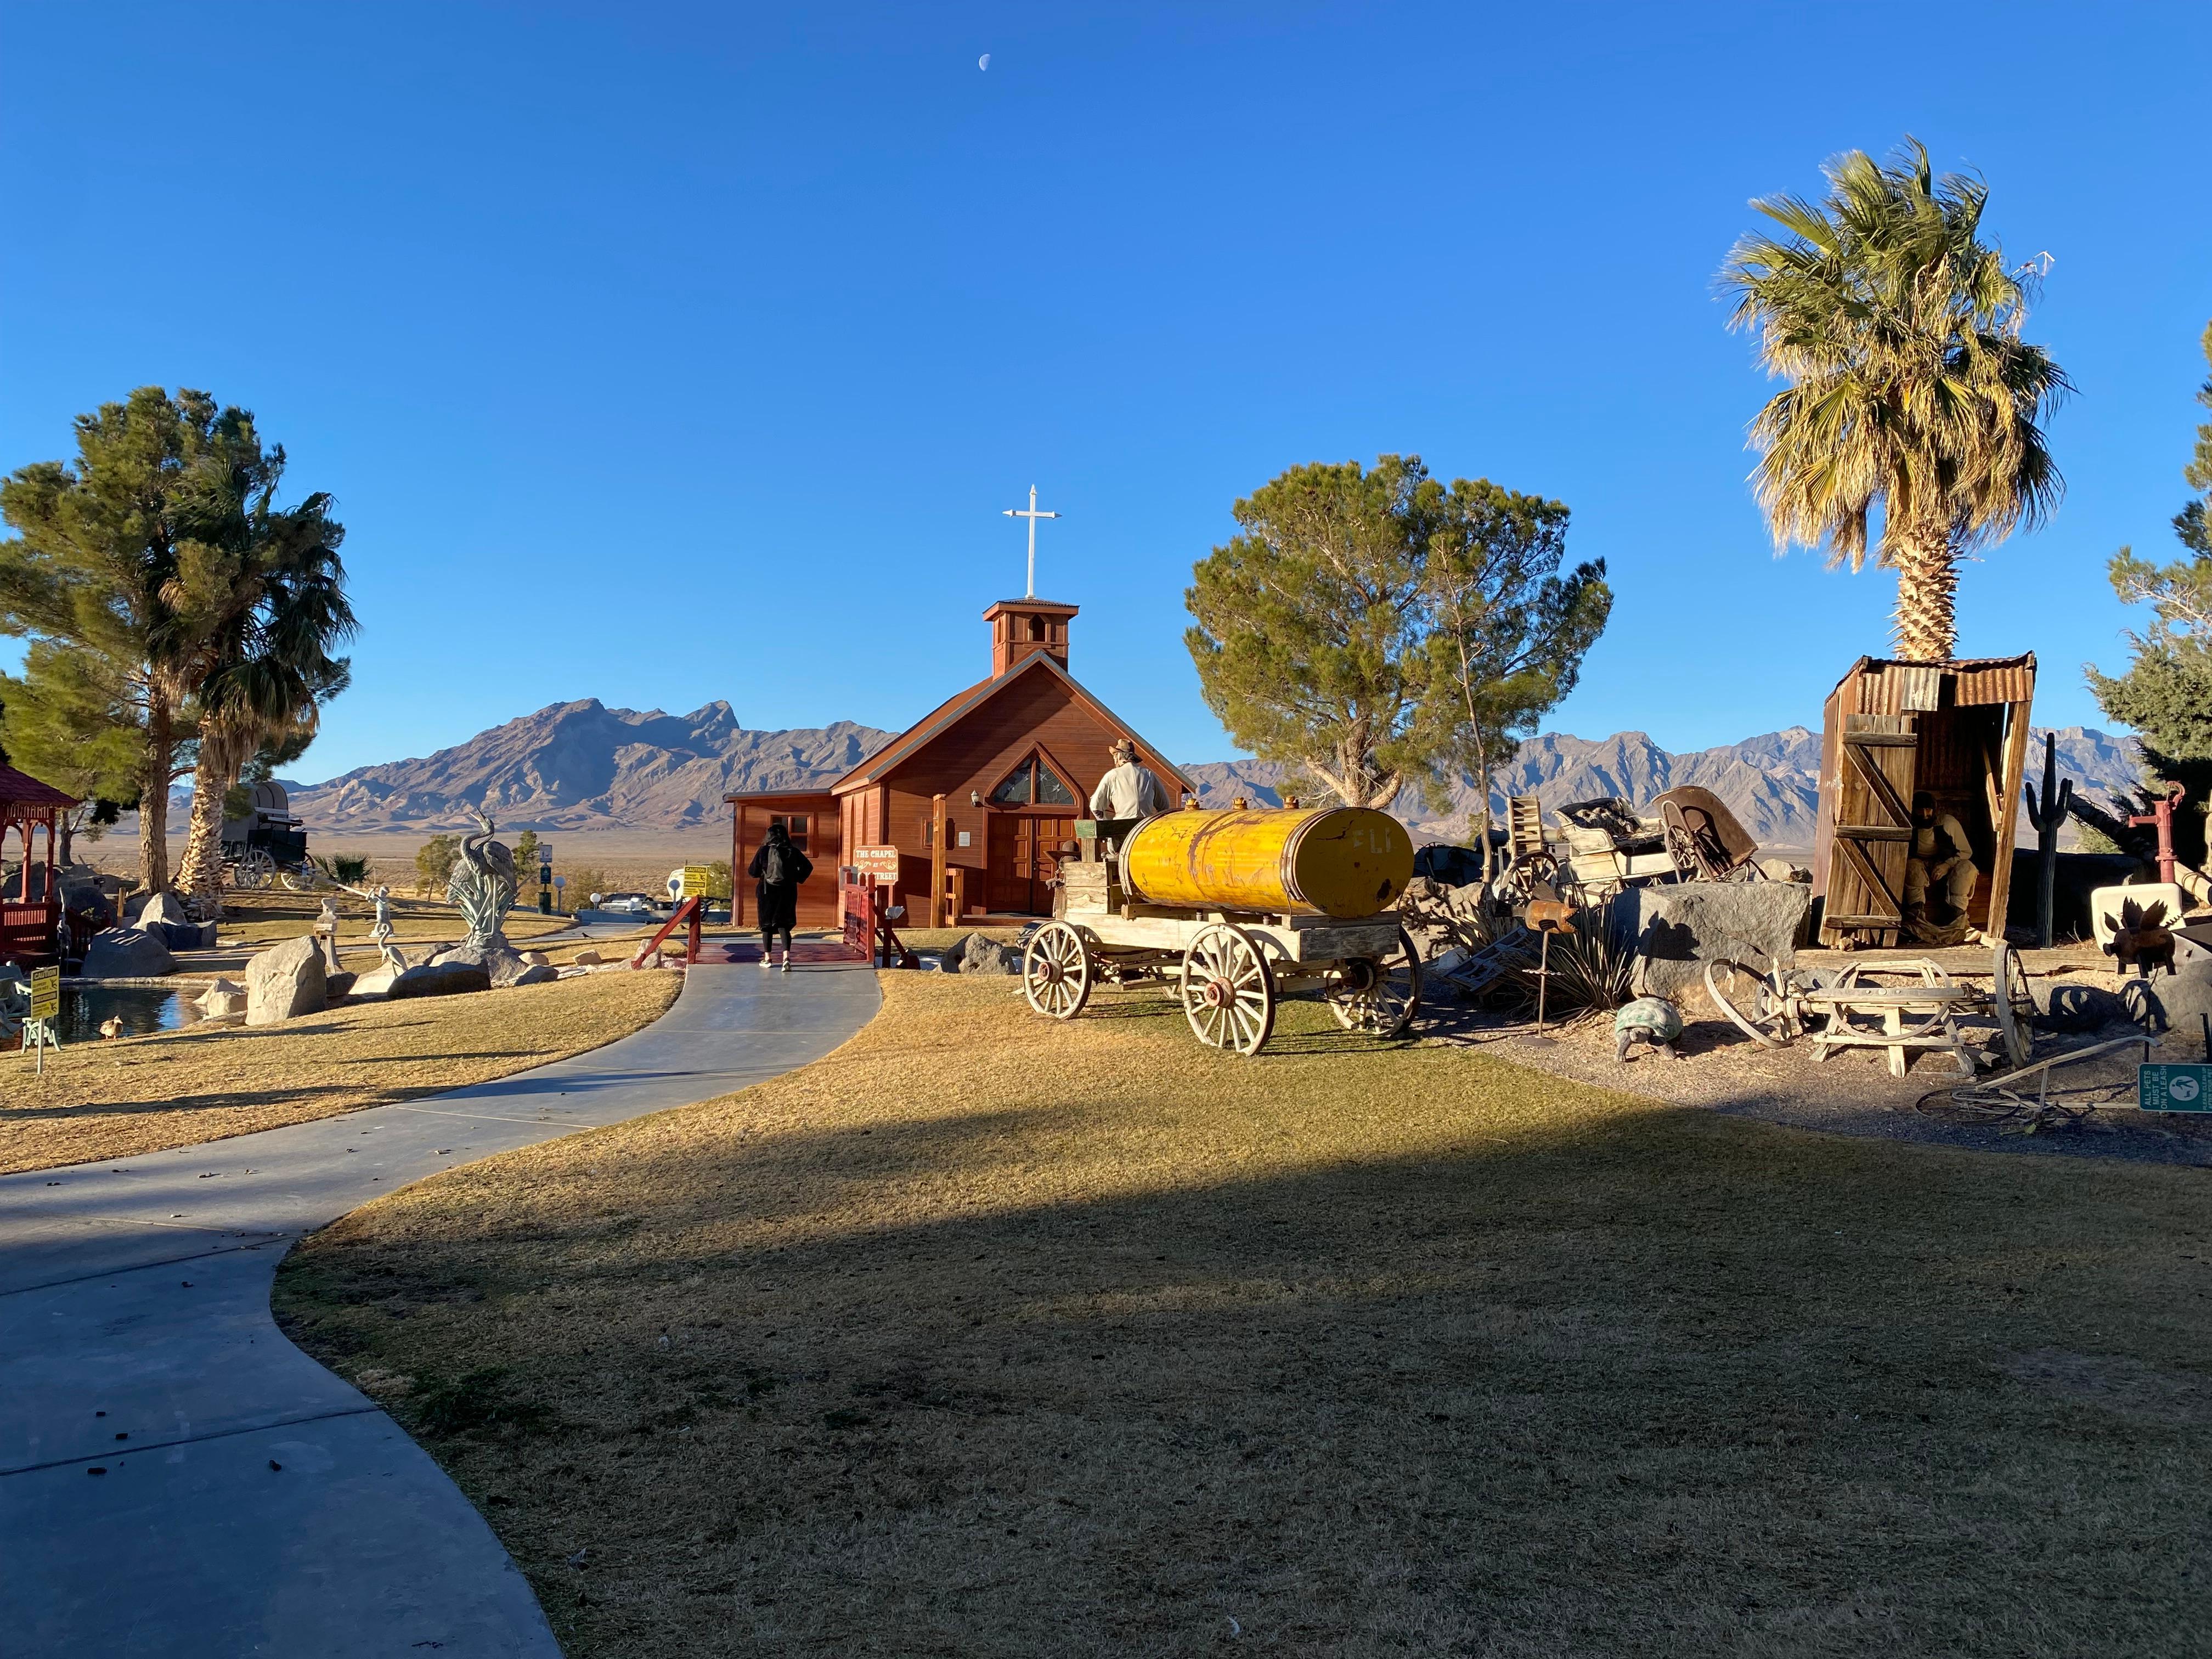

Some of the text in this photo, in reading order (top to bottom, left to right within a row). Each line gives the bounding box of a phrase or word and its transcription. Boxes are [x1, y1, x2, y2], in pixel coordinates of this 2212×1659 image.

[855, 850, 896, 858] THE CHAPEL
[34, 969, 57, 979] CAUTION
[2152, 1071, 2159, 1082] BE
[2160, 1098, 2168, 1109] ON
